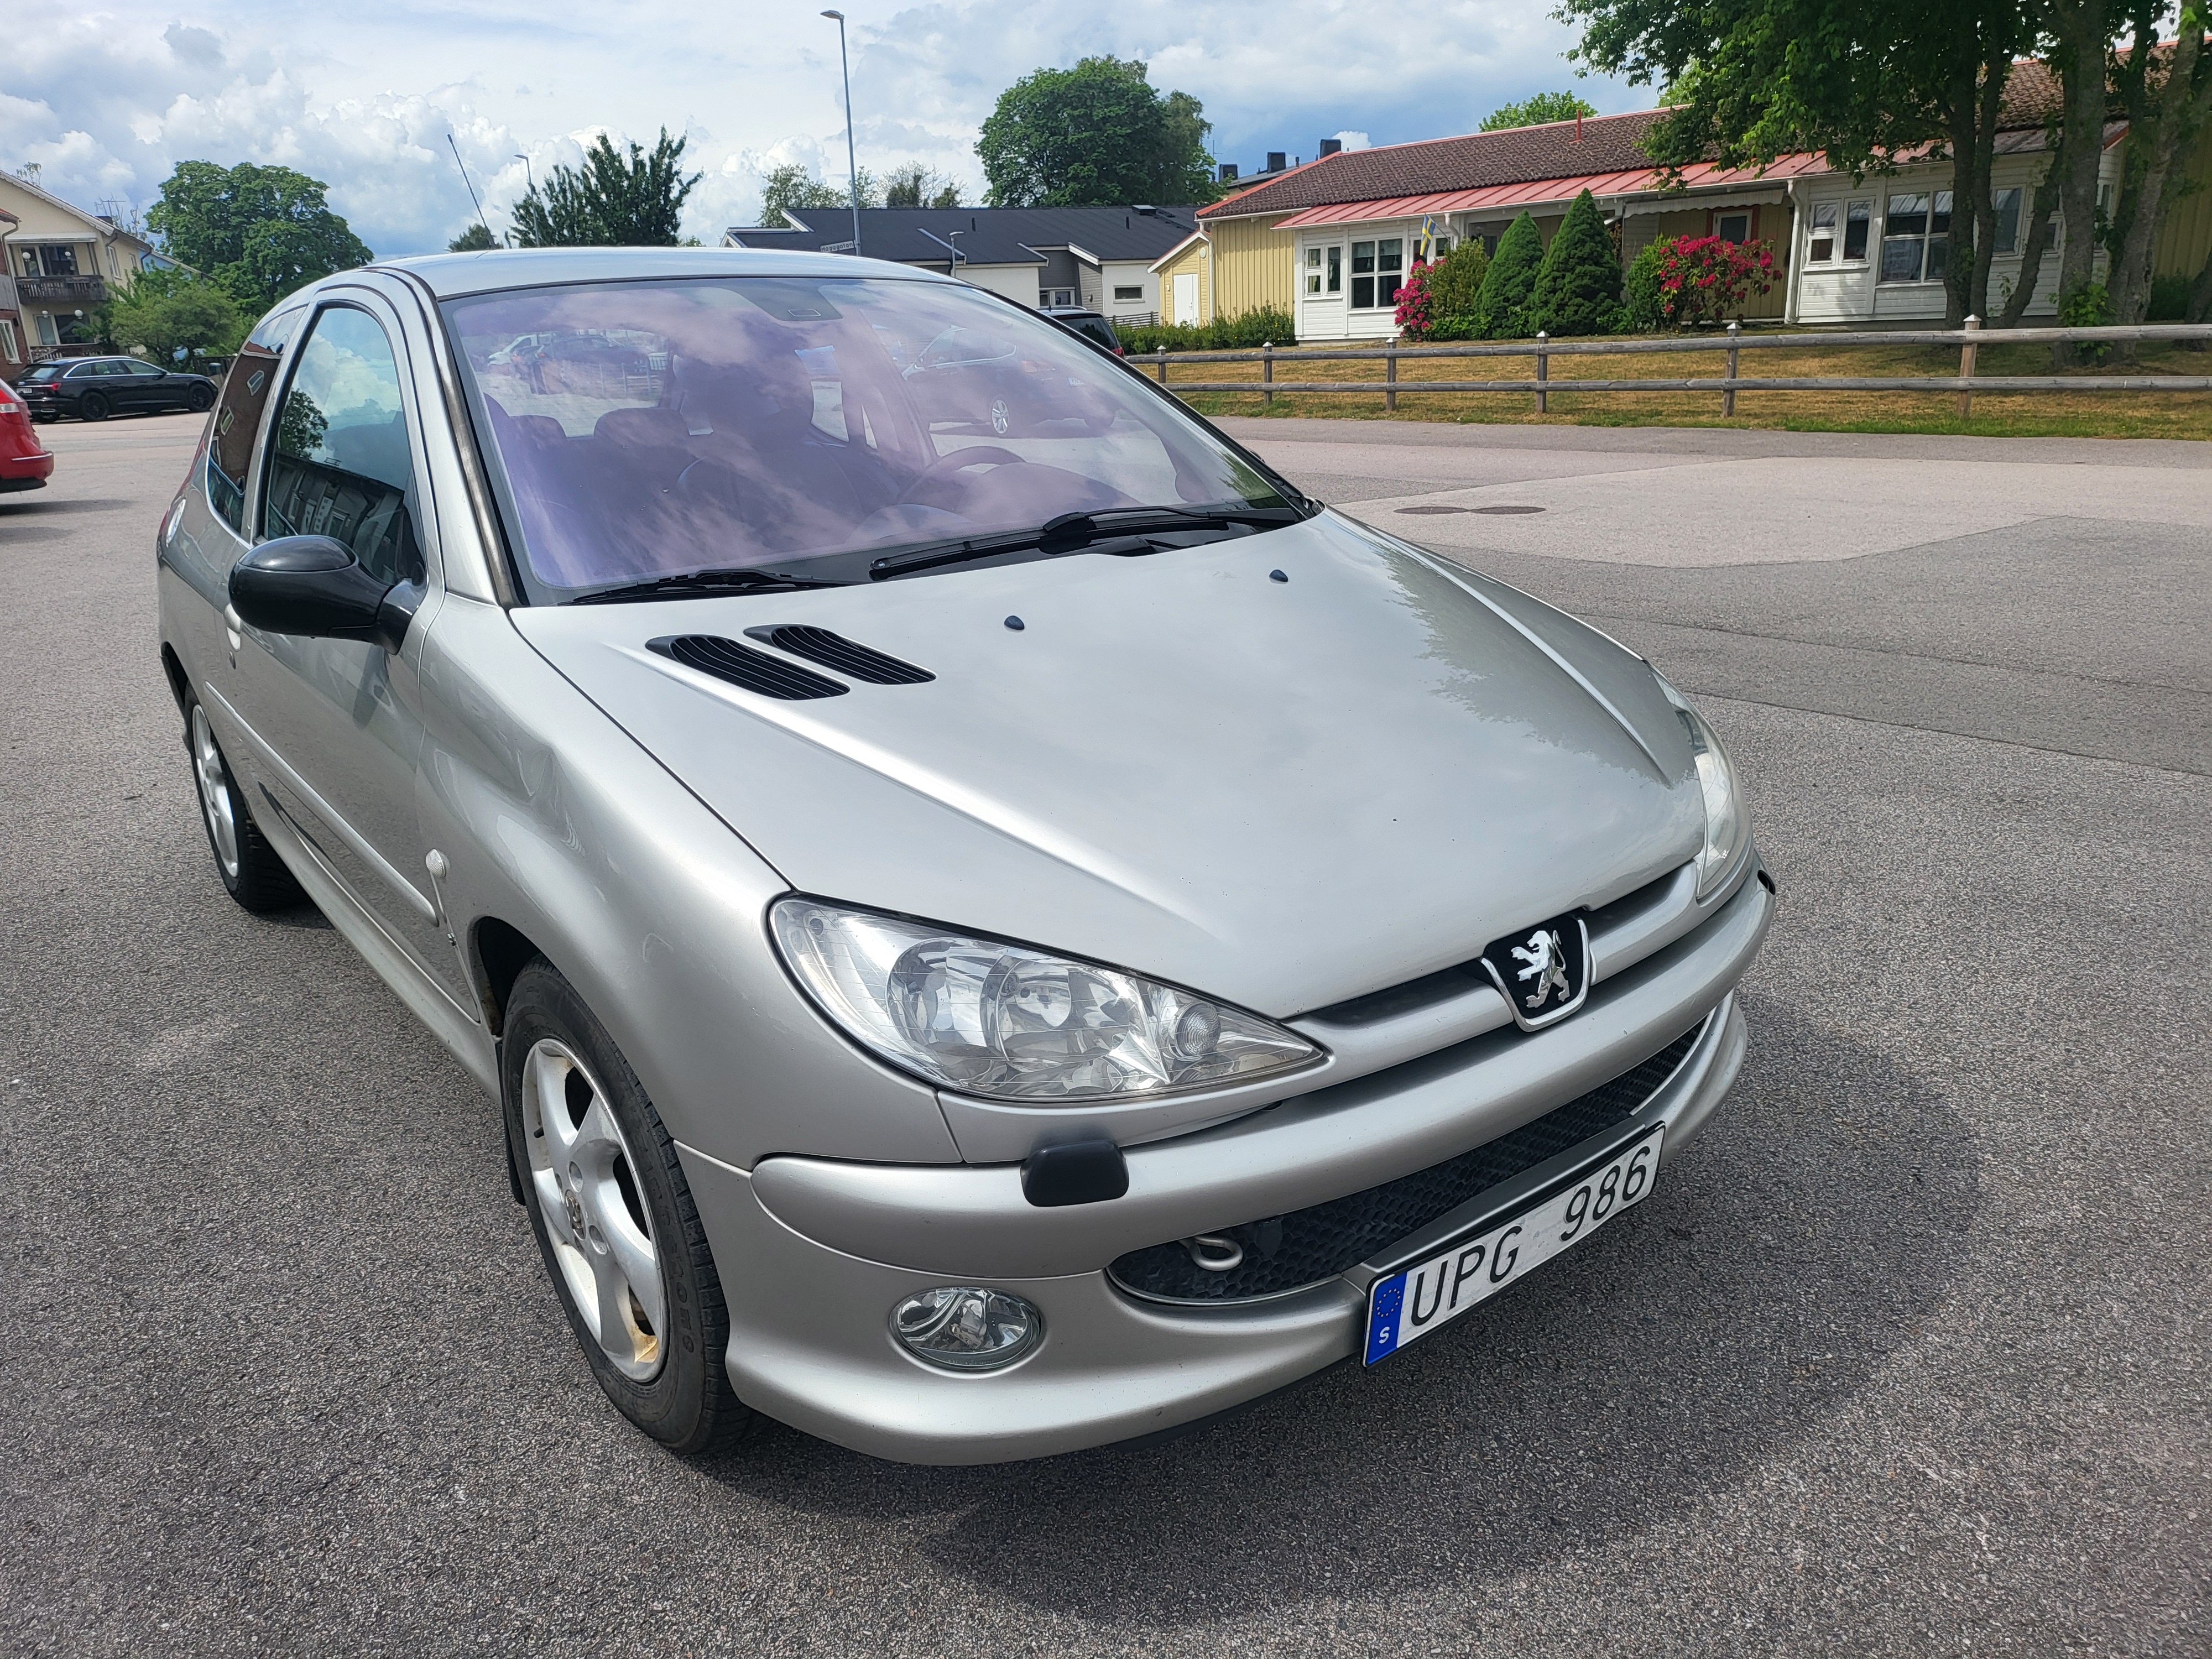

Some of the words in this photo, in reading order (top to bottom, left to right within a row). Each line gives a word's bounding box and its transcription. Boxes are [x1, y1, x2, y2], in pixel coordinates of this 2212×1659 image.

[1411, 1225, 1523, 1326] UPG
[1559, 1146, 1651, 1242] 986
[1379, 1326, 1390, 1344] S
